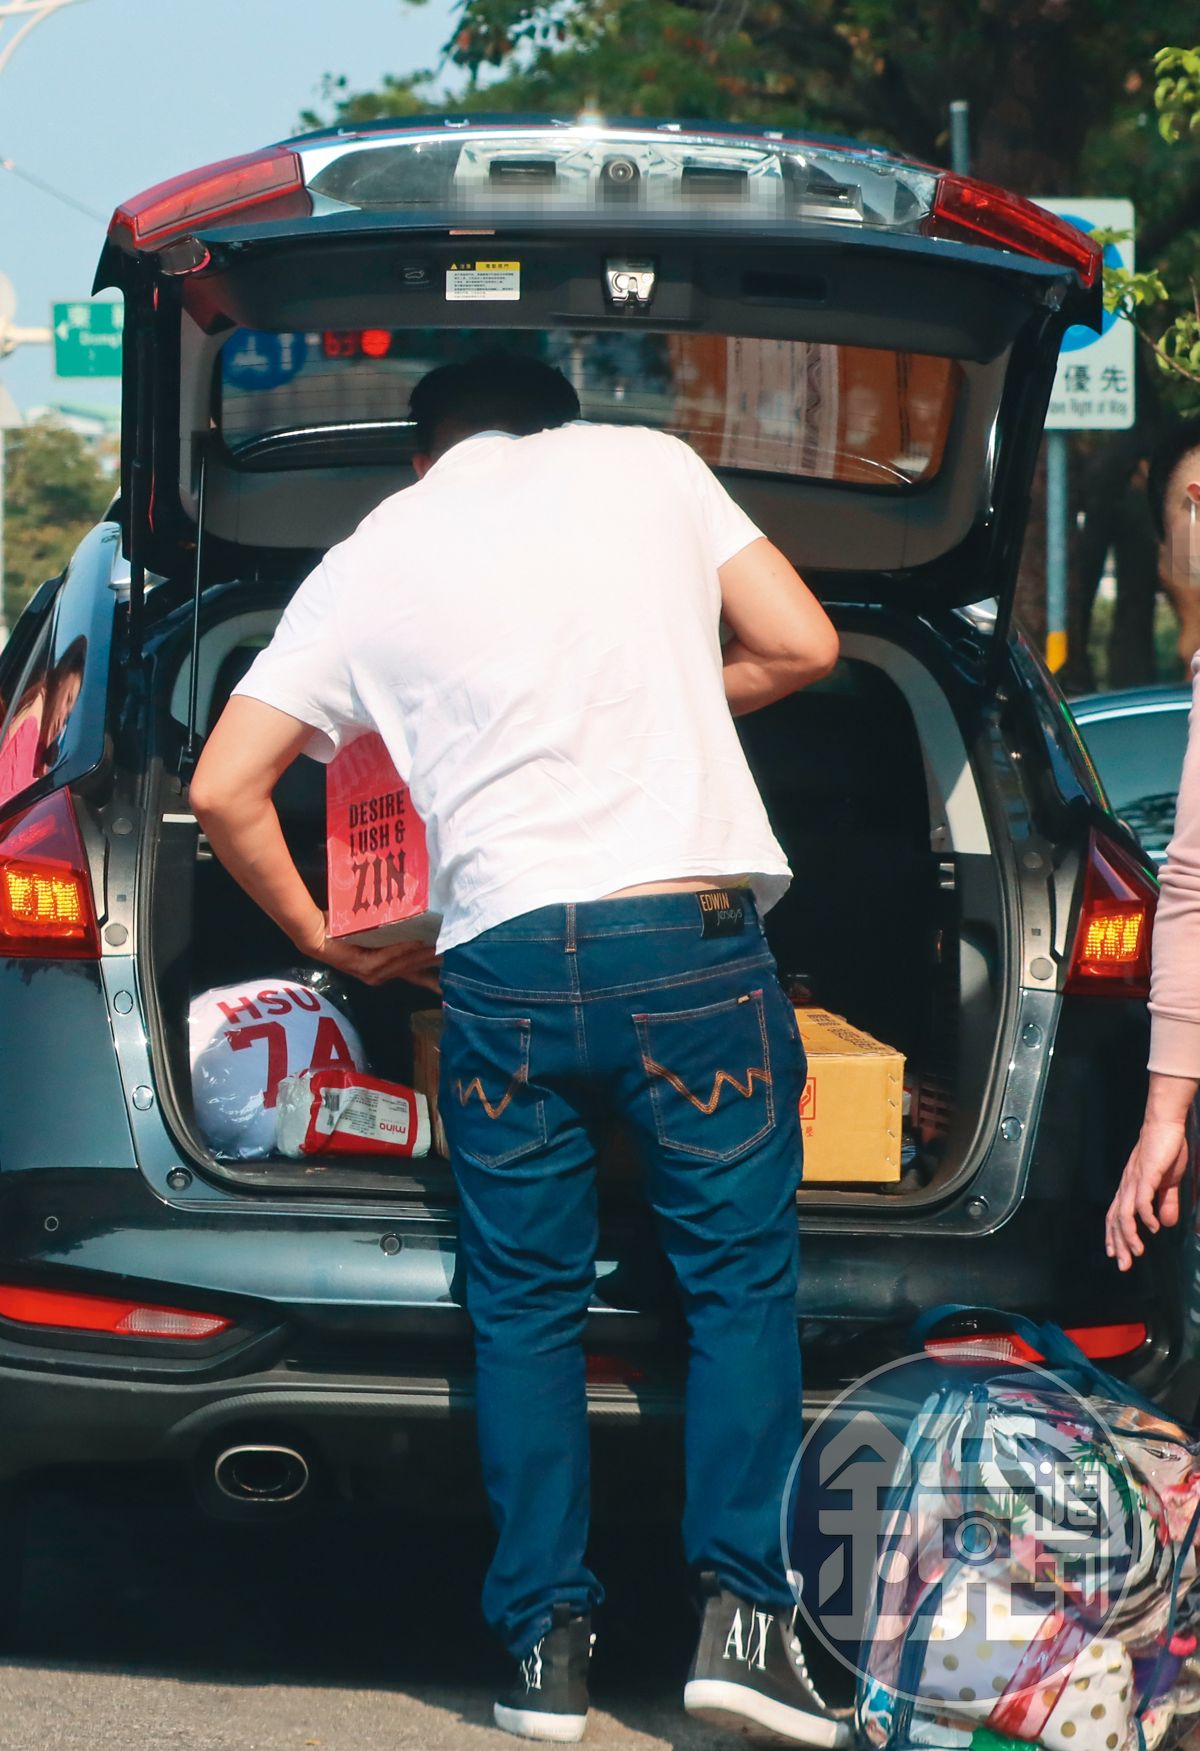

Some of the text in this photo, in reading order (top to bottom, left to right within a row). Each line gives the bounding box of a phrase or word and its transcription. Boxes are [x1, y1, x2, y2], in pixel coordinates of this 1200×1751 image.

[1064, 365, 1128, 393] 優先
[349, 790, 406, 829] DESIRE
[349, 819, 406, 857] LUSH &
[351, 849, 406, 915] ZIN
[700, 892, 730, 912] EDWIN
[217, 987, 321, 1024] HSU
